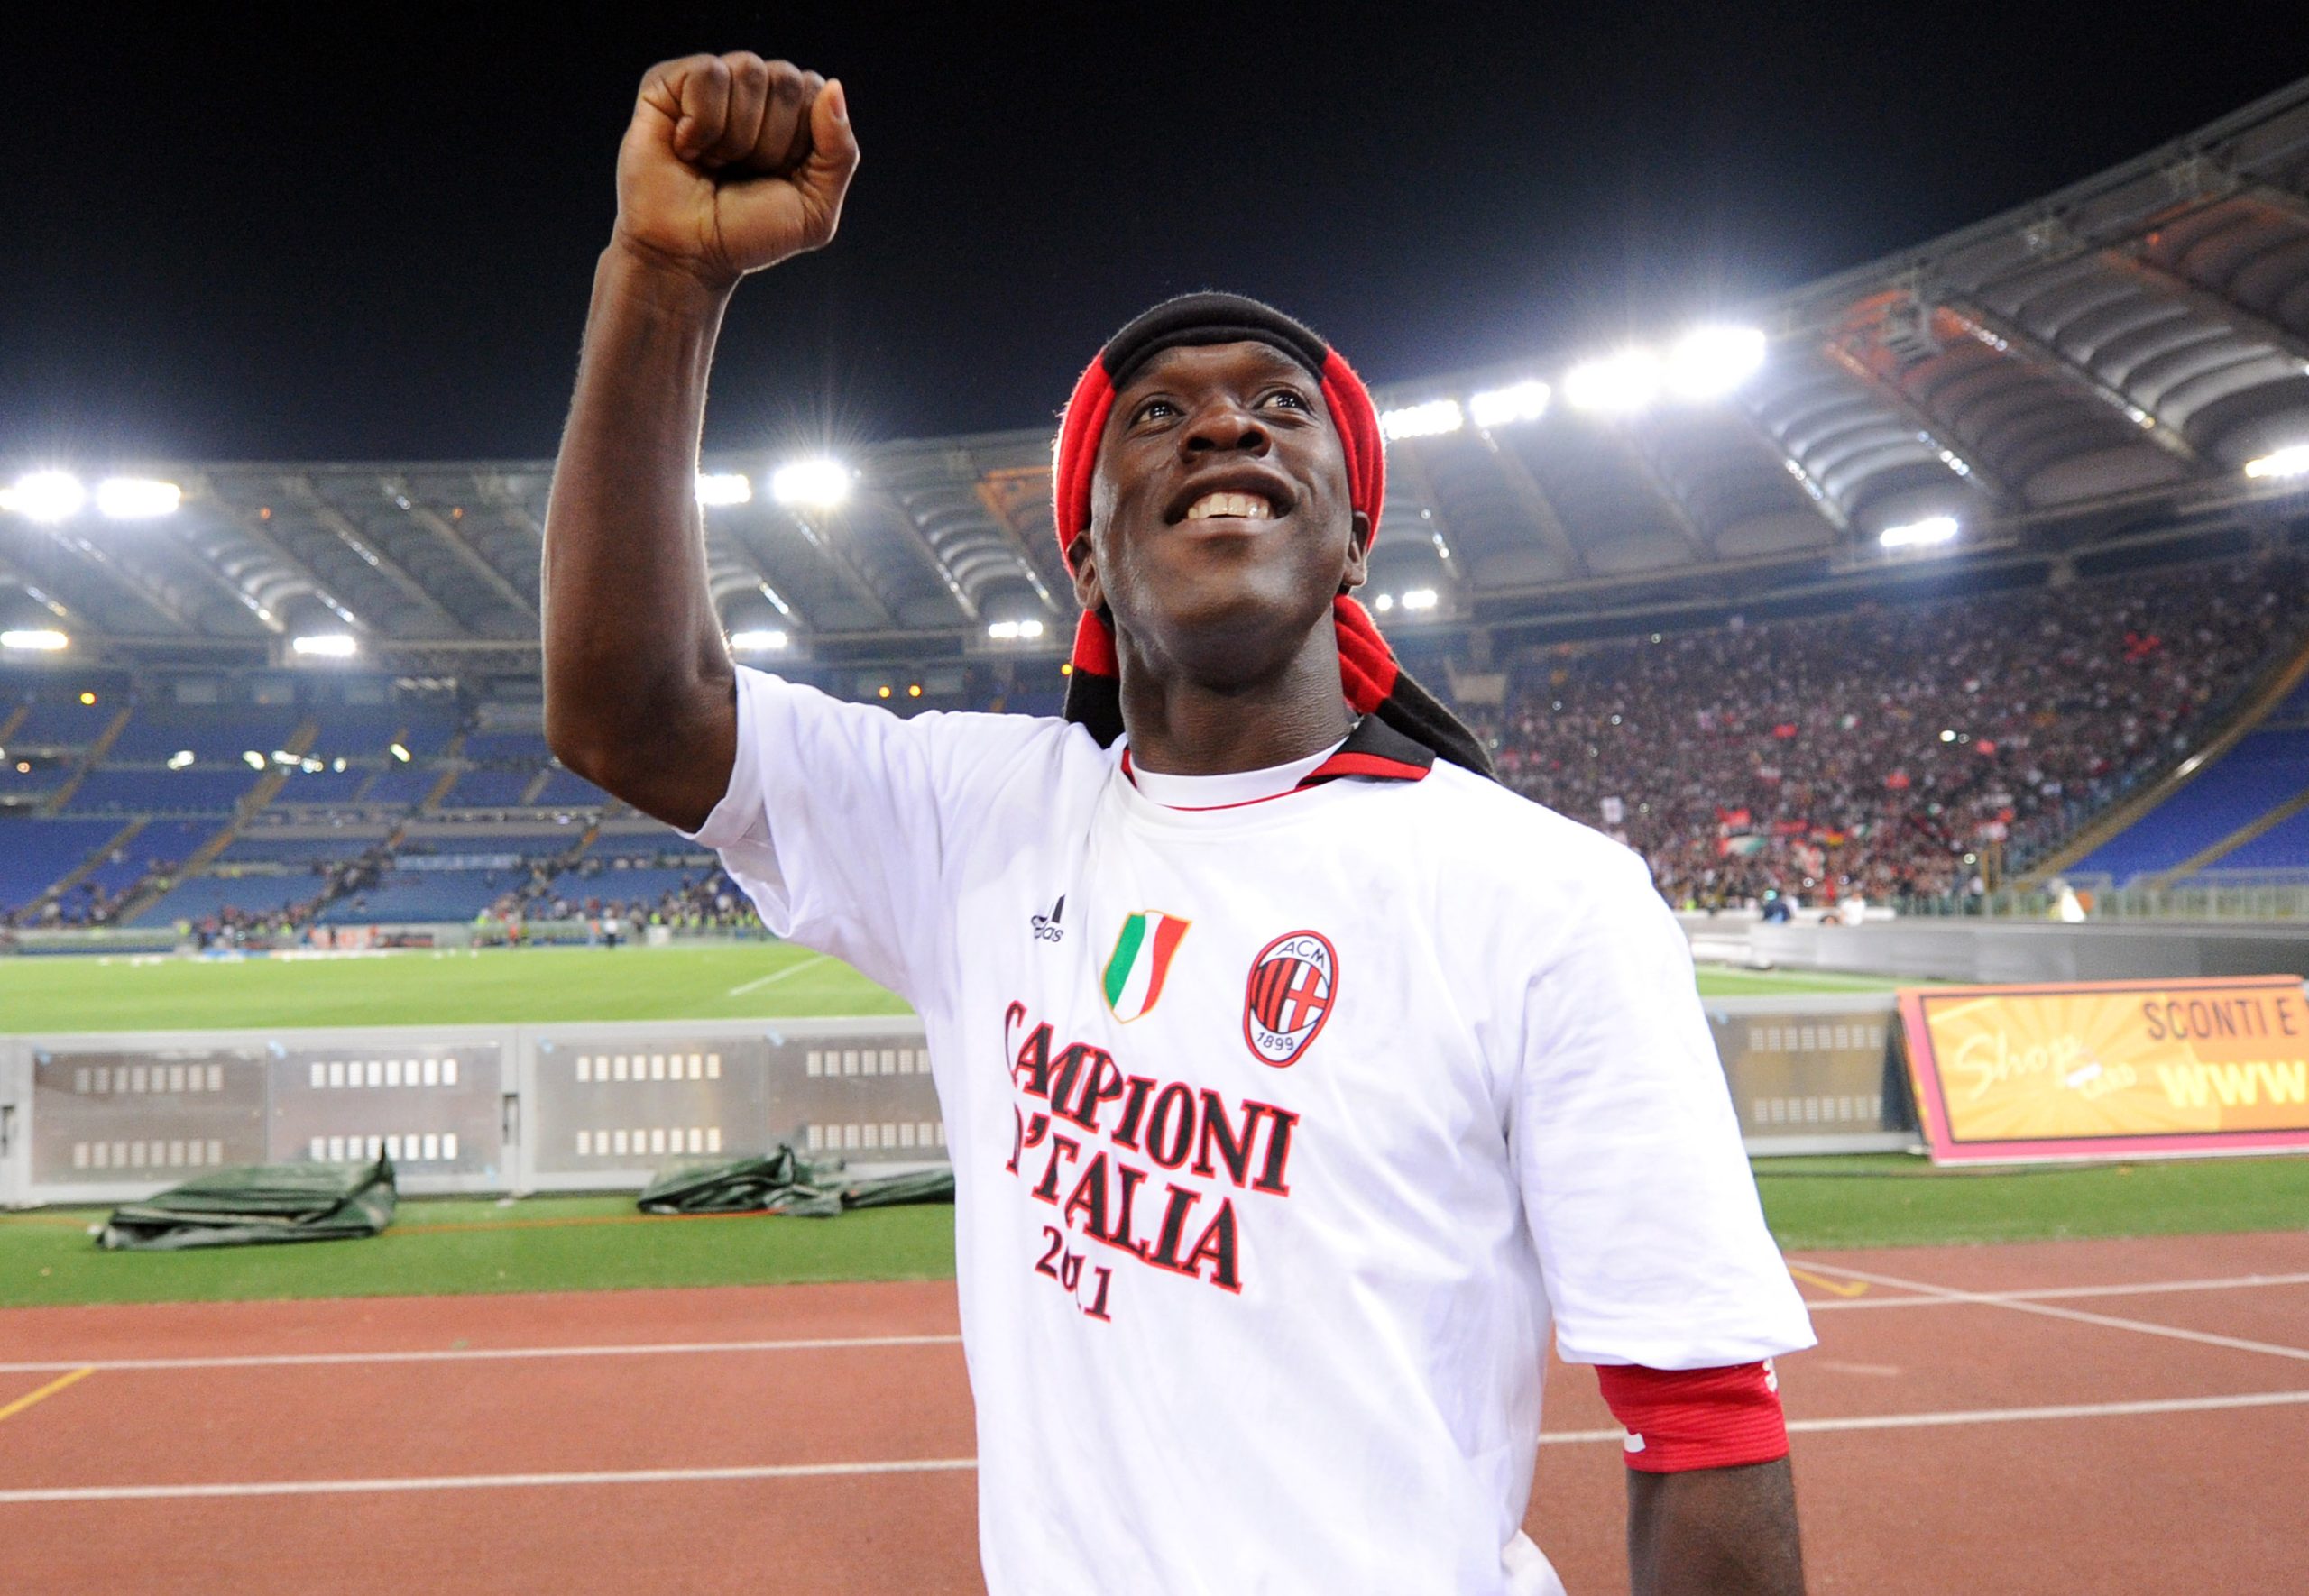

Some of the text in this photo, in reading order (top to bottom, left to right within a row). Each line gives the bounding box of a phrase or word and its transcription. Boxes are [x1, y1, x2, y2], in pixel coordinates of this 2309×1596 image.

[1276, 940, 1325, 968] ACM
[2144, 998, 2297, 1040] SCONTI E
[1256, 1032, 1294, 1050] 1899
